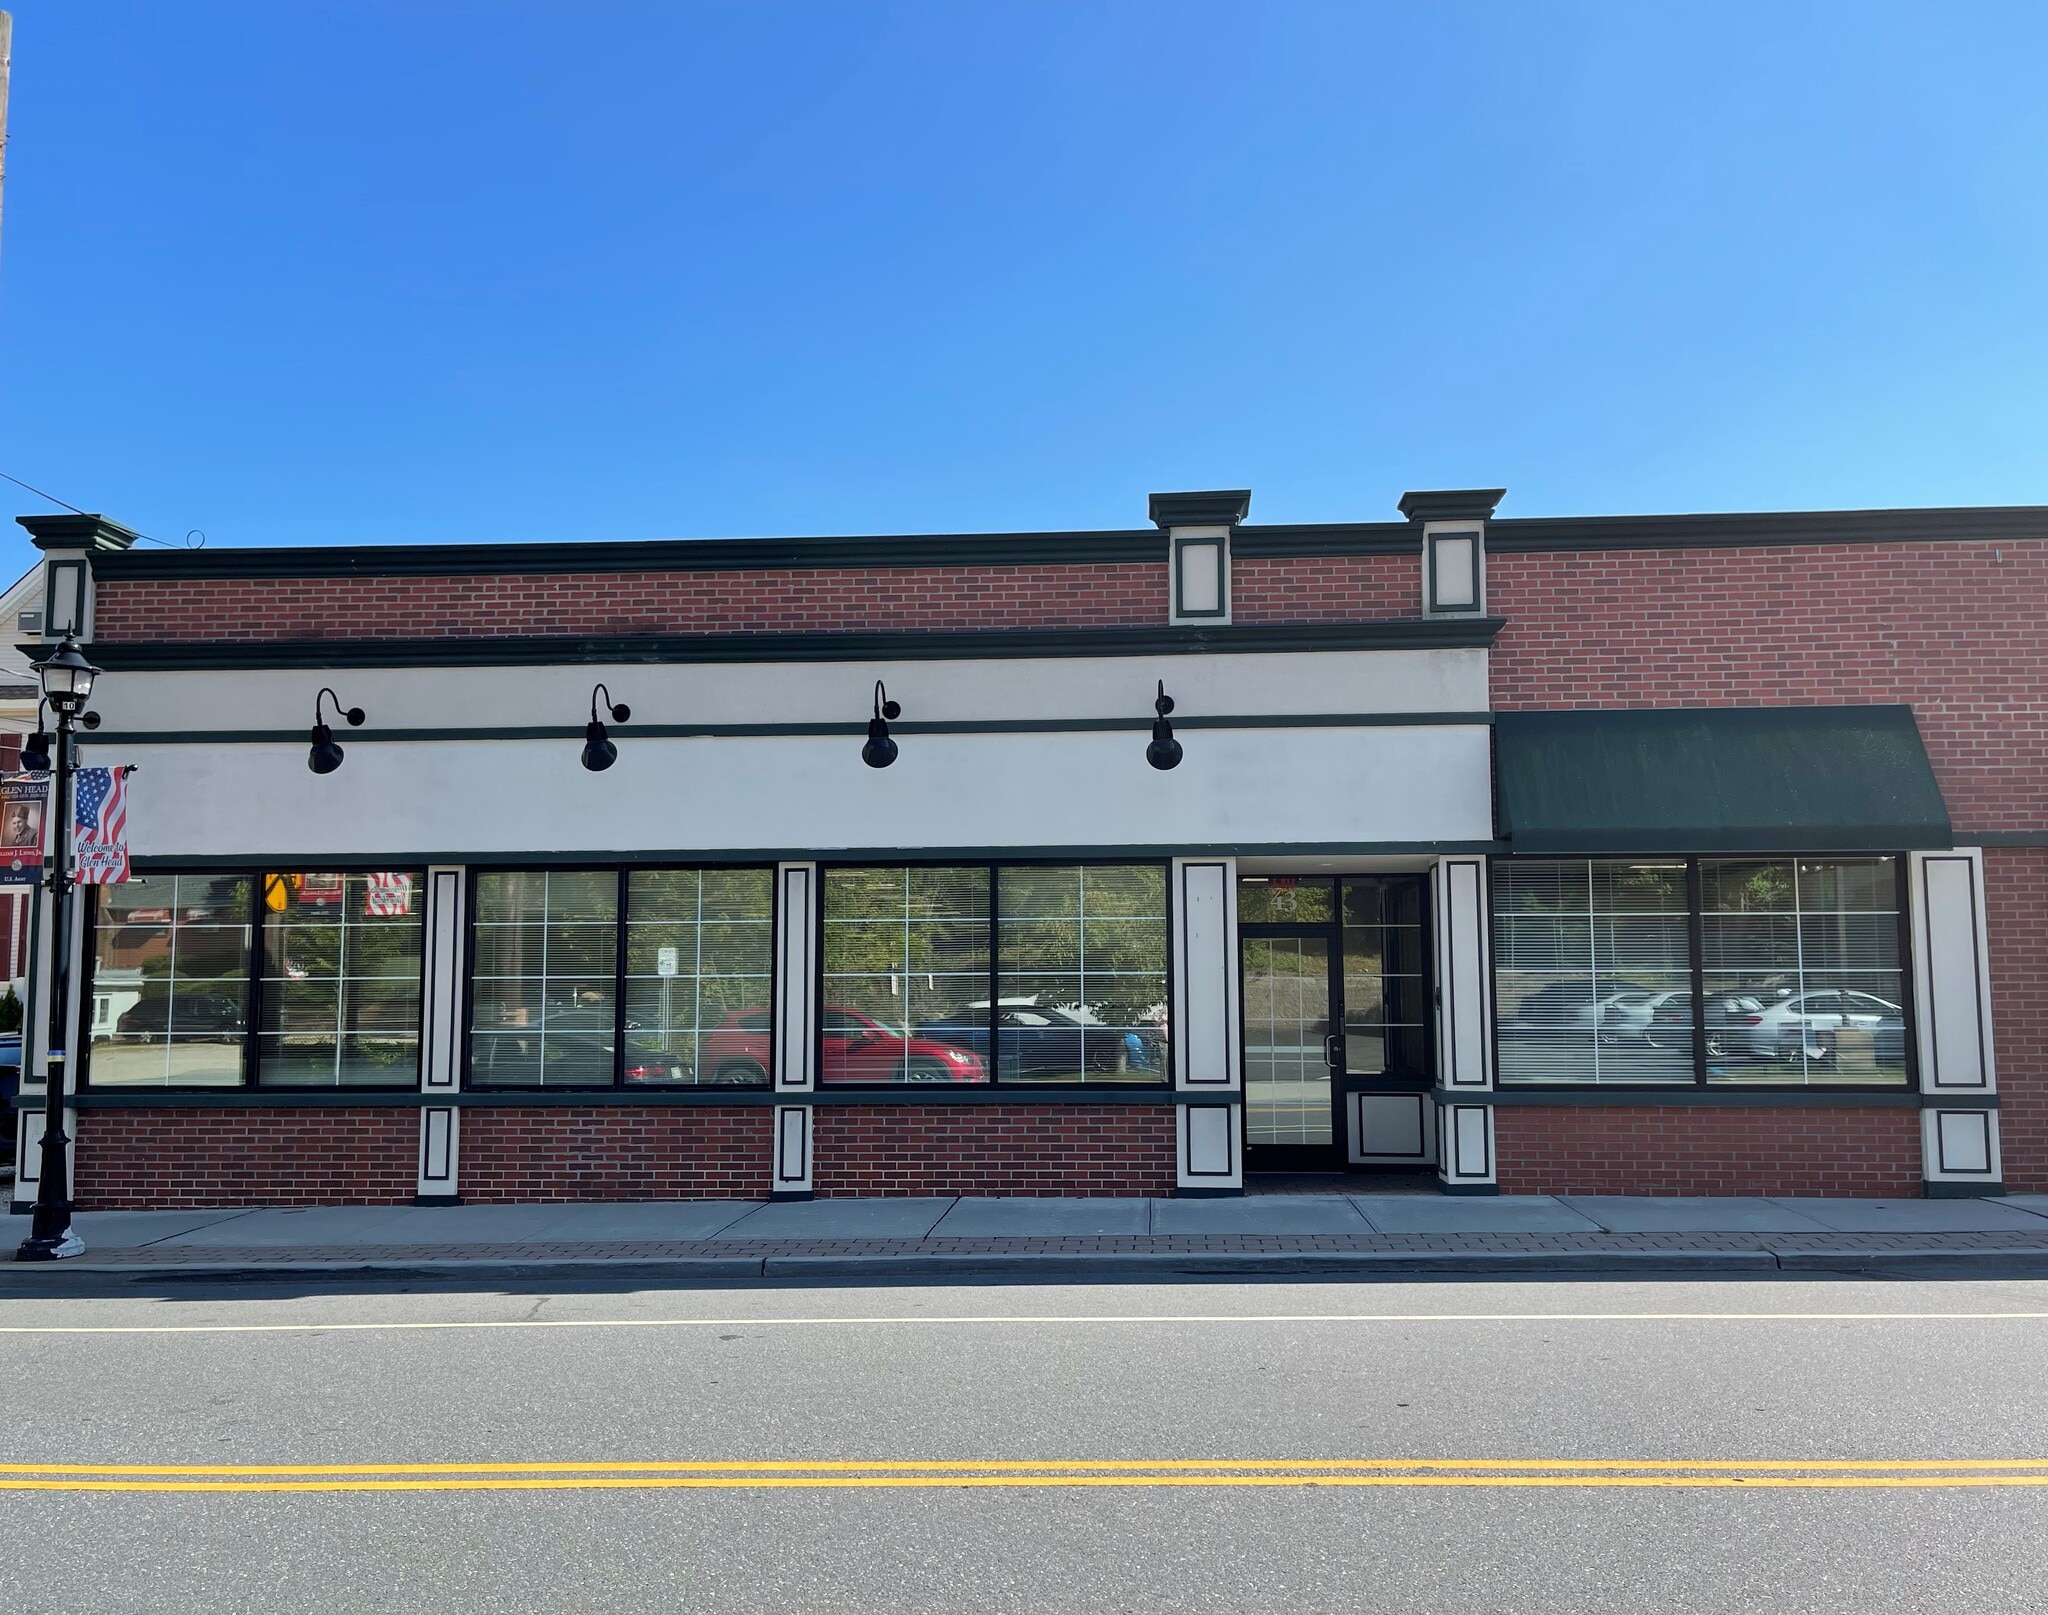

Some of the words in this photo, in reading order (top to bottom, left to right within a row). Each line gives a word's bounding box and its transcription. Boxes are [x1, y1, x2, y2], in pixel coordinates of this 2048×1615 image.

[1, 786, 23, 794] GLEN
[24, 785, 49, 793] HEAD
[78, 841, 115, 853] Welcome
[115, 842, 124, 852] to
[80, 855, 99, 868] Glen
[100, 854, 123, 867] Head
[1270, 888, 1298, 912] 43
